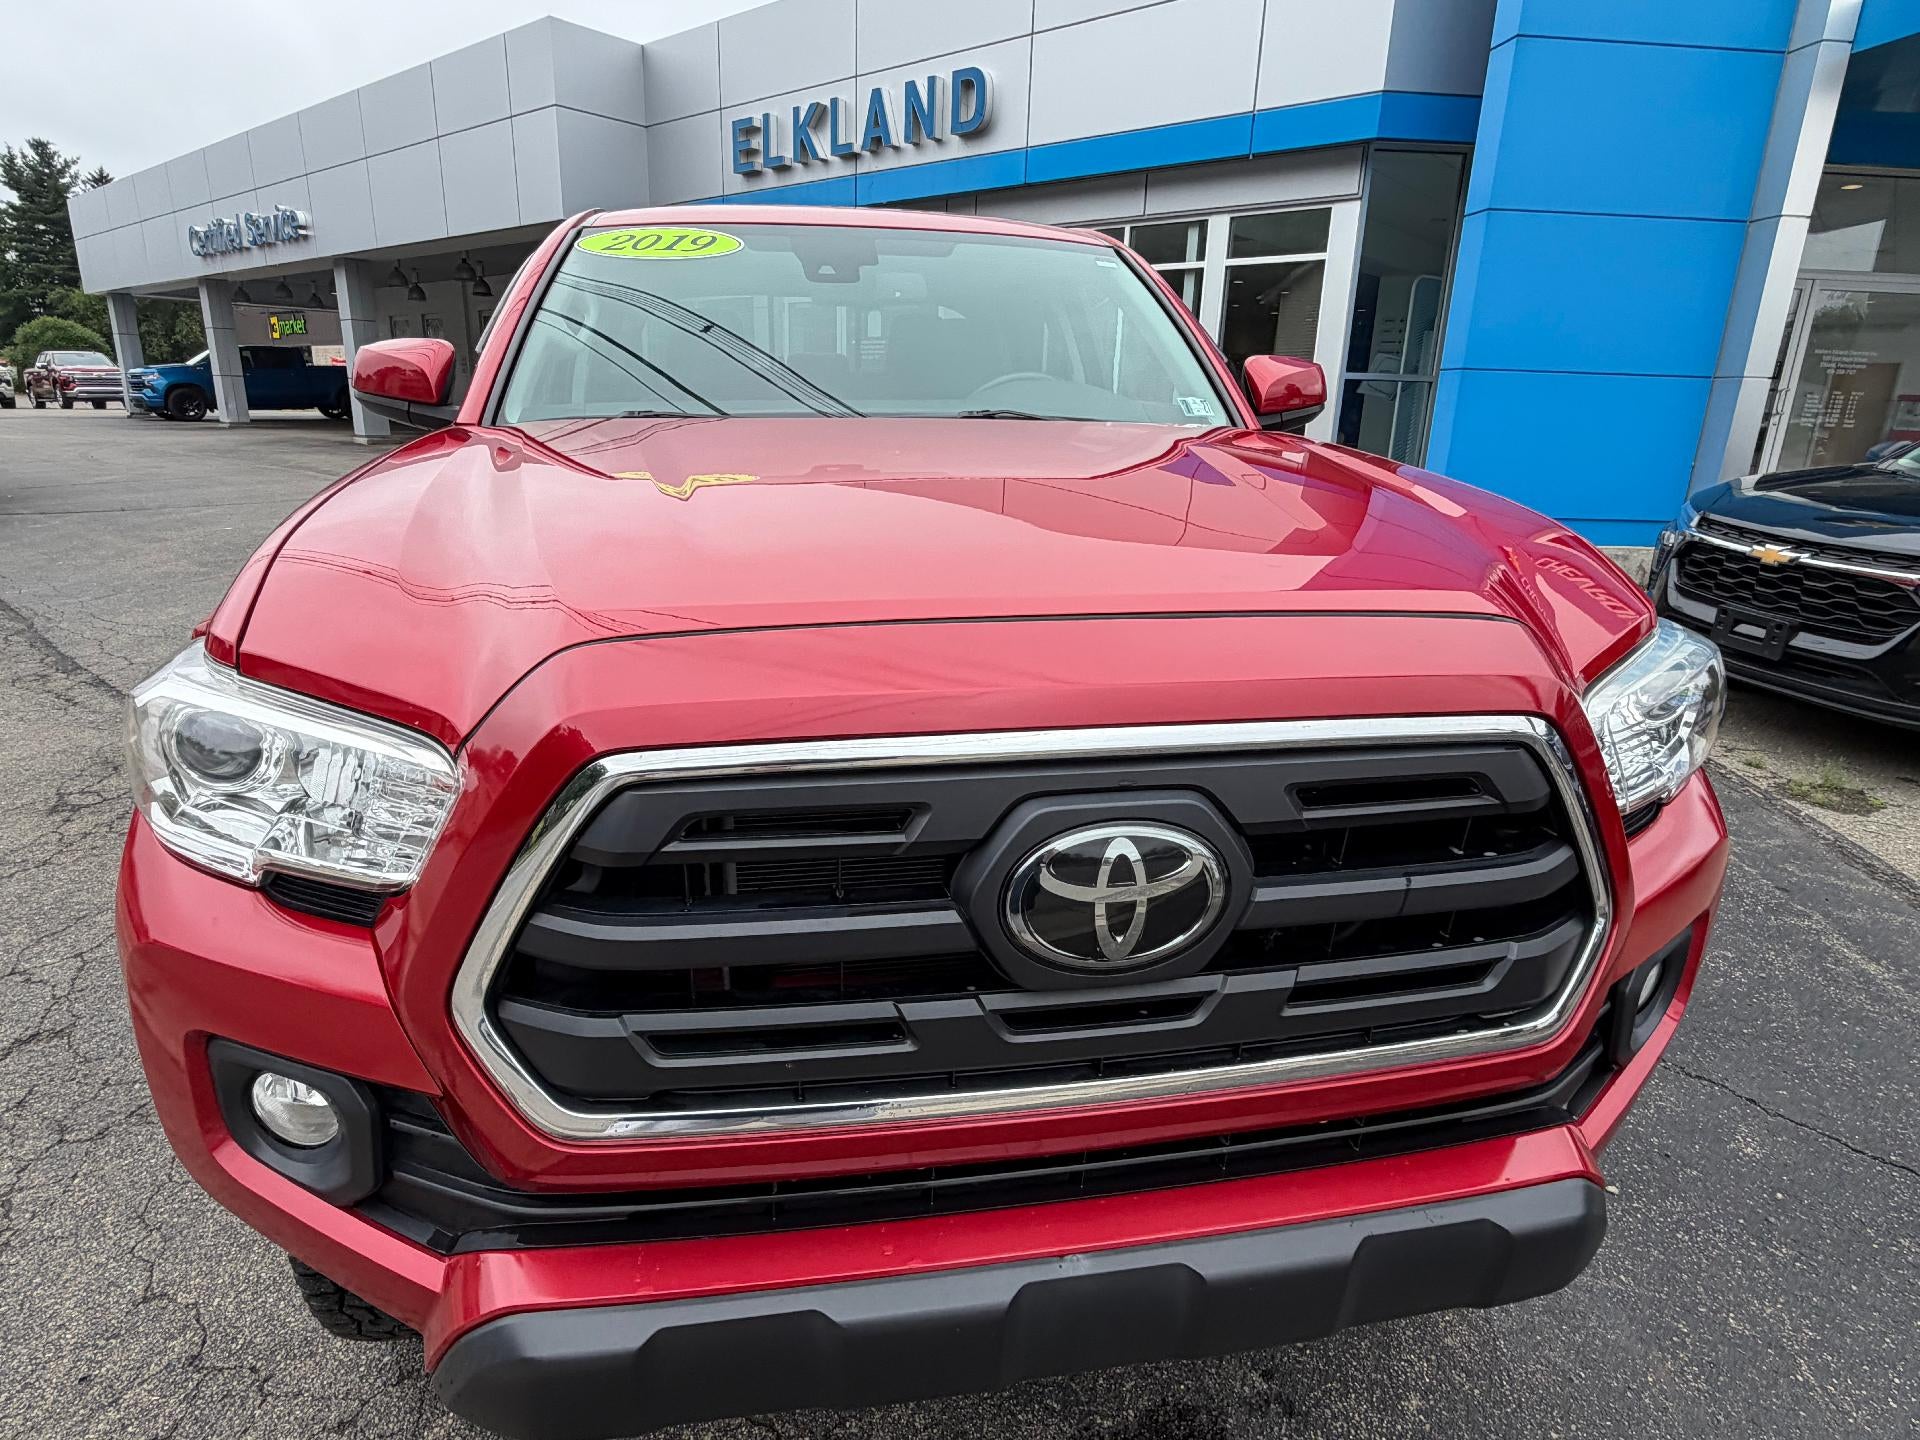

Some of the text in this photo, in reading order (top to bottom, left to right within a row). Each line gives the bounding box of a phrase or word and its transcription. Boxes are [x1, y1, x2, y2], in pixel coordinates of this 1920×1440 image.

[732, 66, 993, 175] ELKLAND
[245, 204, 303, 246] Service
[601, 234, 718, 252] 2019
[279, 313, 306, 336] market
